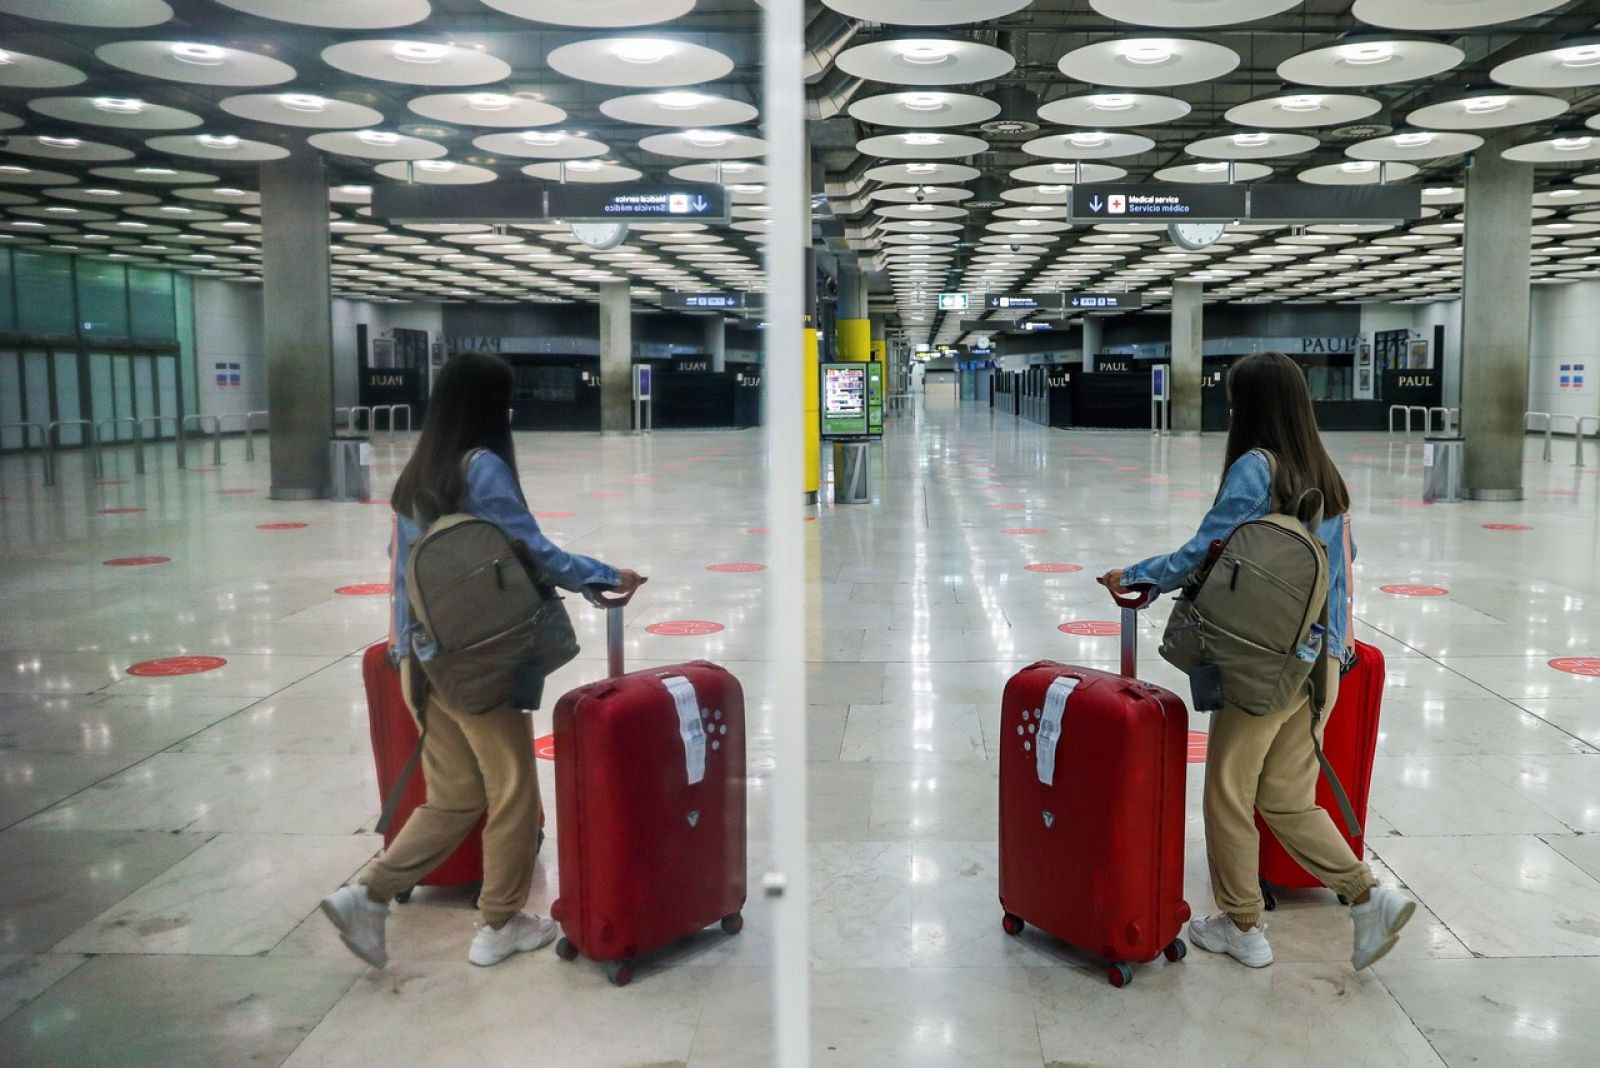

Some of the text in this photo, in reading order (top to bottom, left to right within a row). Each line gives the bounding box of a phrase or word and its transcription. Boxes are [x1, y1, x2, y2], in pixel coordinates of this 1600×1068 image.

[1128, 195, 1154, 203] Medical
[1129, 204, 1190, 212] Servicio médico
[1099, 362, 1128, 371] PAUL
[1398, 376, 1433, 387] PAUL
